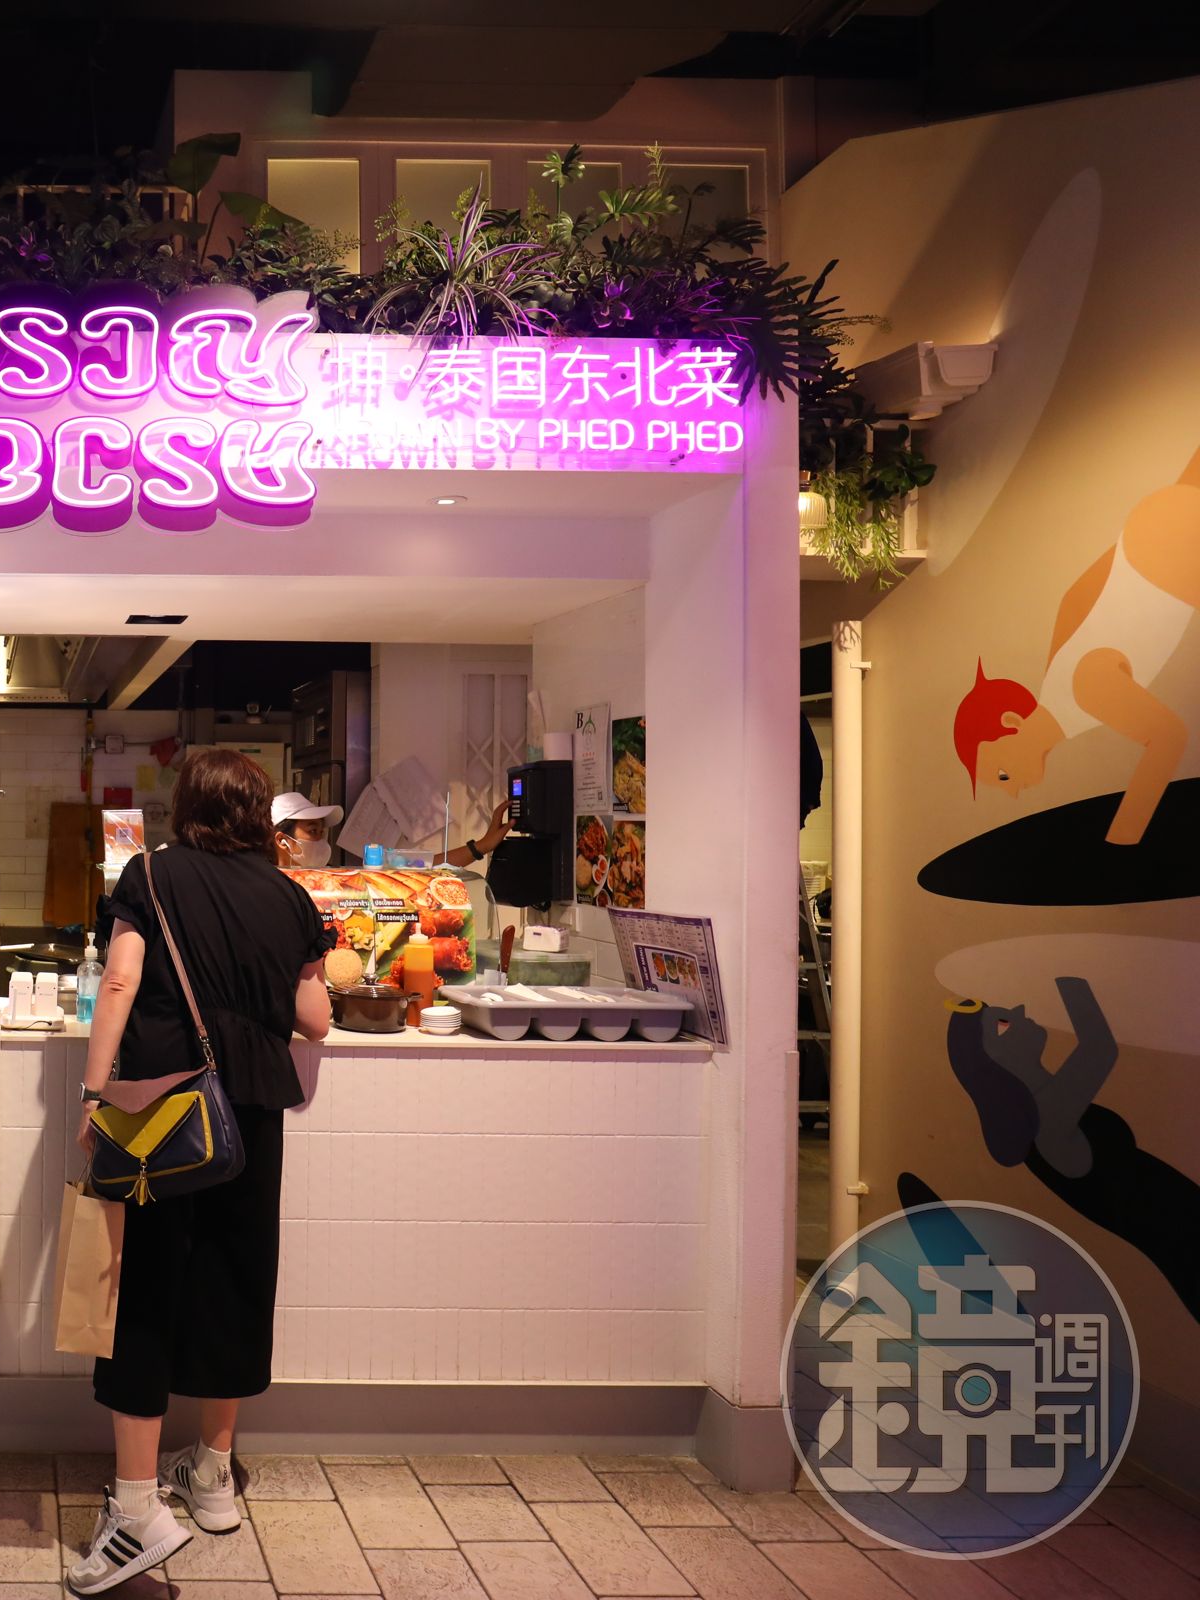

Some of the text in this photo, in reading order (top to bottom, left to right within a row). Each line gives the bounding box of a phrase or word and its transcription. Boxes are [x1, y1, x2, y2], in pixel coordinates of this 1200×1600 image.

[474, 417, 525, 450] BY
[537, 419, 635, 452] PHED
[646, 420, 745, 455] PHED
